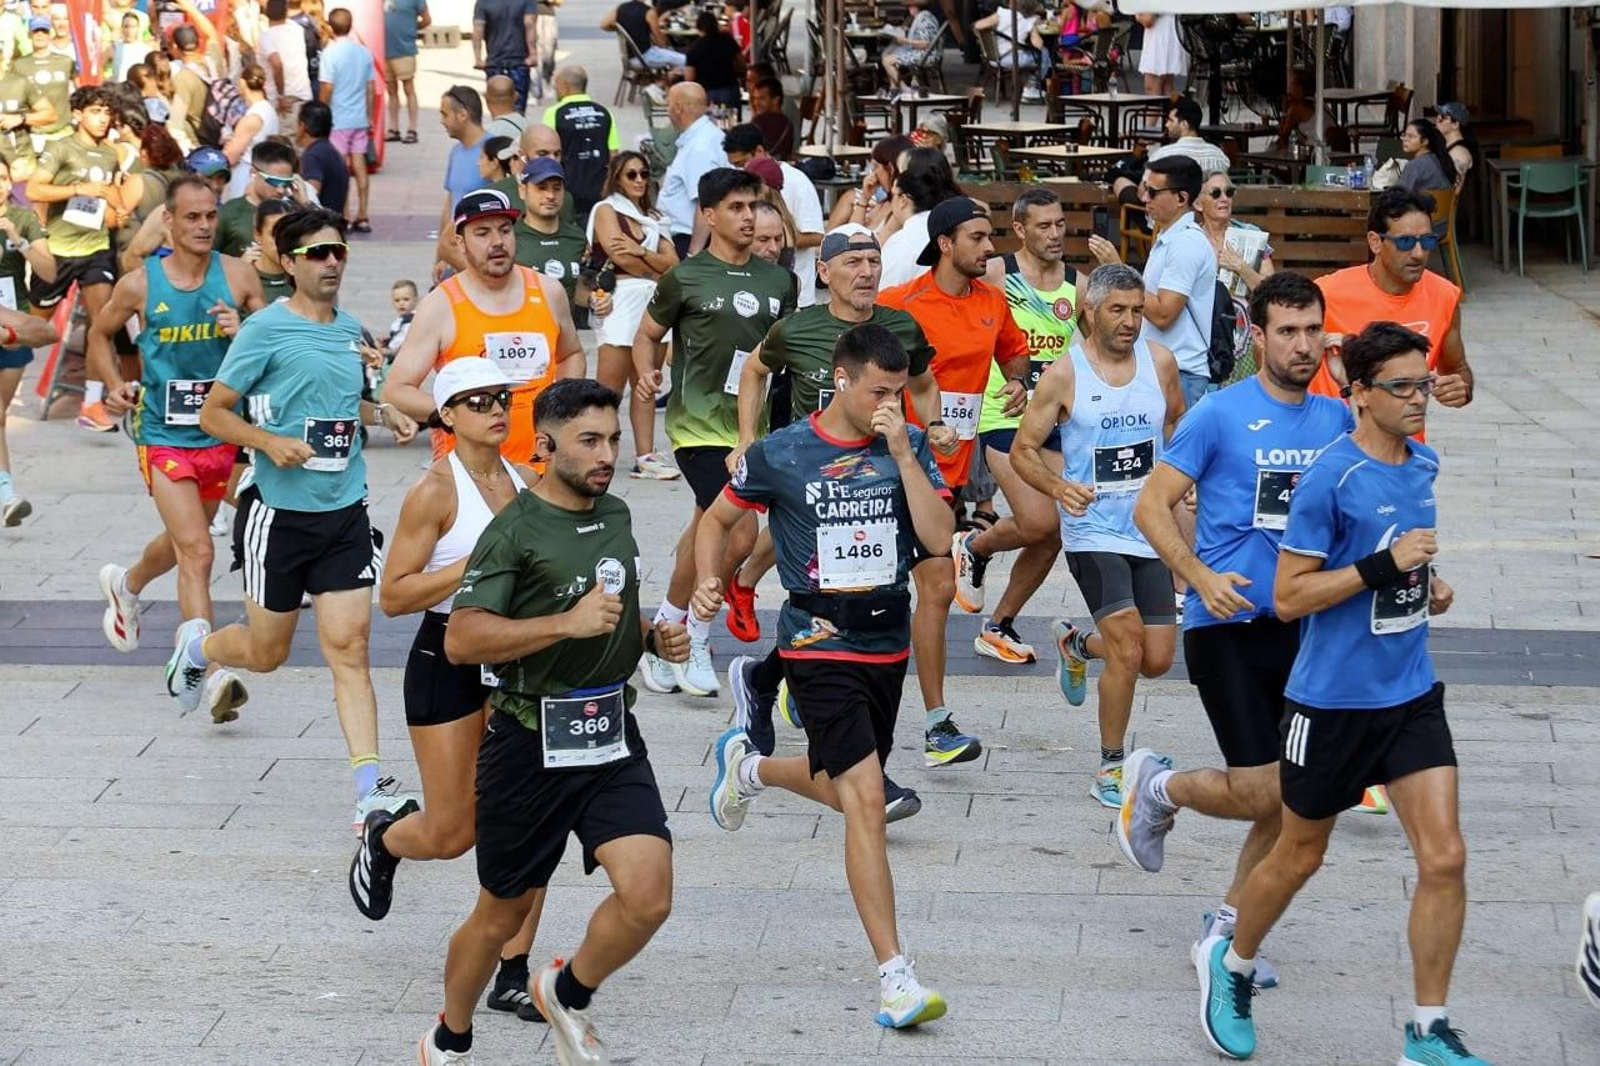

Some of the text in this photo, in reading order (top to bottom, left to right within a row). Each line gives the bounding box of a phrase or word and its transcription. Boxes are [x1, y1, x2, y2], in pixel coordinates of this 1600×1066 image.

[1022, 329, 1066, 355] izos
[499, 347, 537, 359] 1007
[183, 394, 209, 406] 25
[942, 407, 974, 419] 1586
[323, 434, 350, 448] 361
[1112, 457, 1142, 472] 124
[1278, 489, 1297, 503] 4
[815, 498, 894, 519] CARREIRA
[834, 543, 883, 560] 1486
[569, 716, 610, 735] 360
